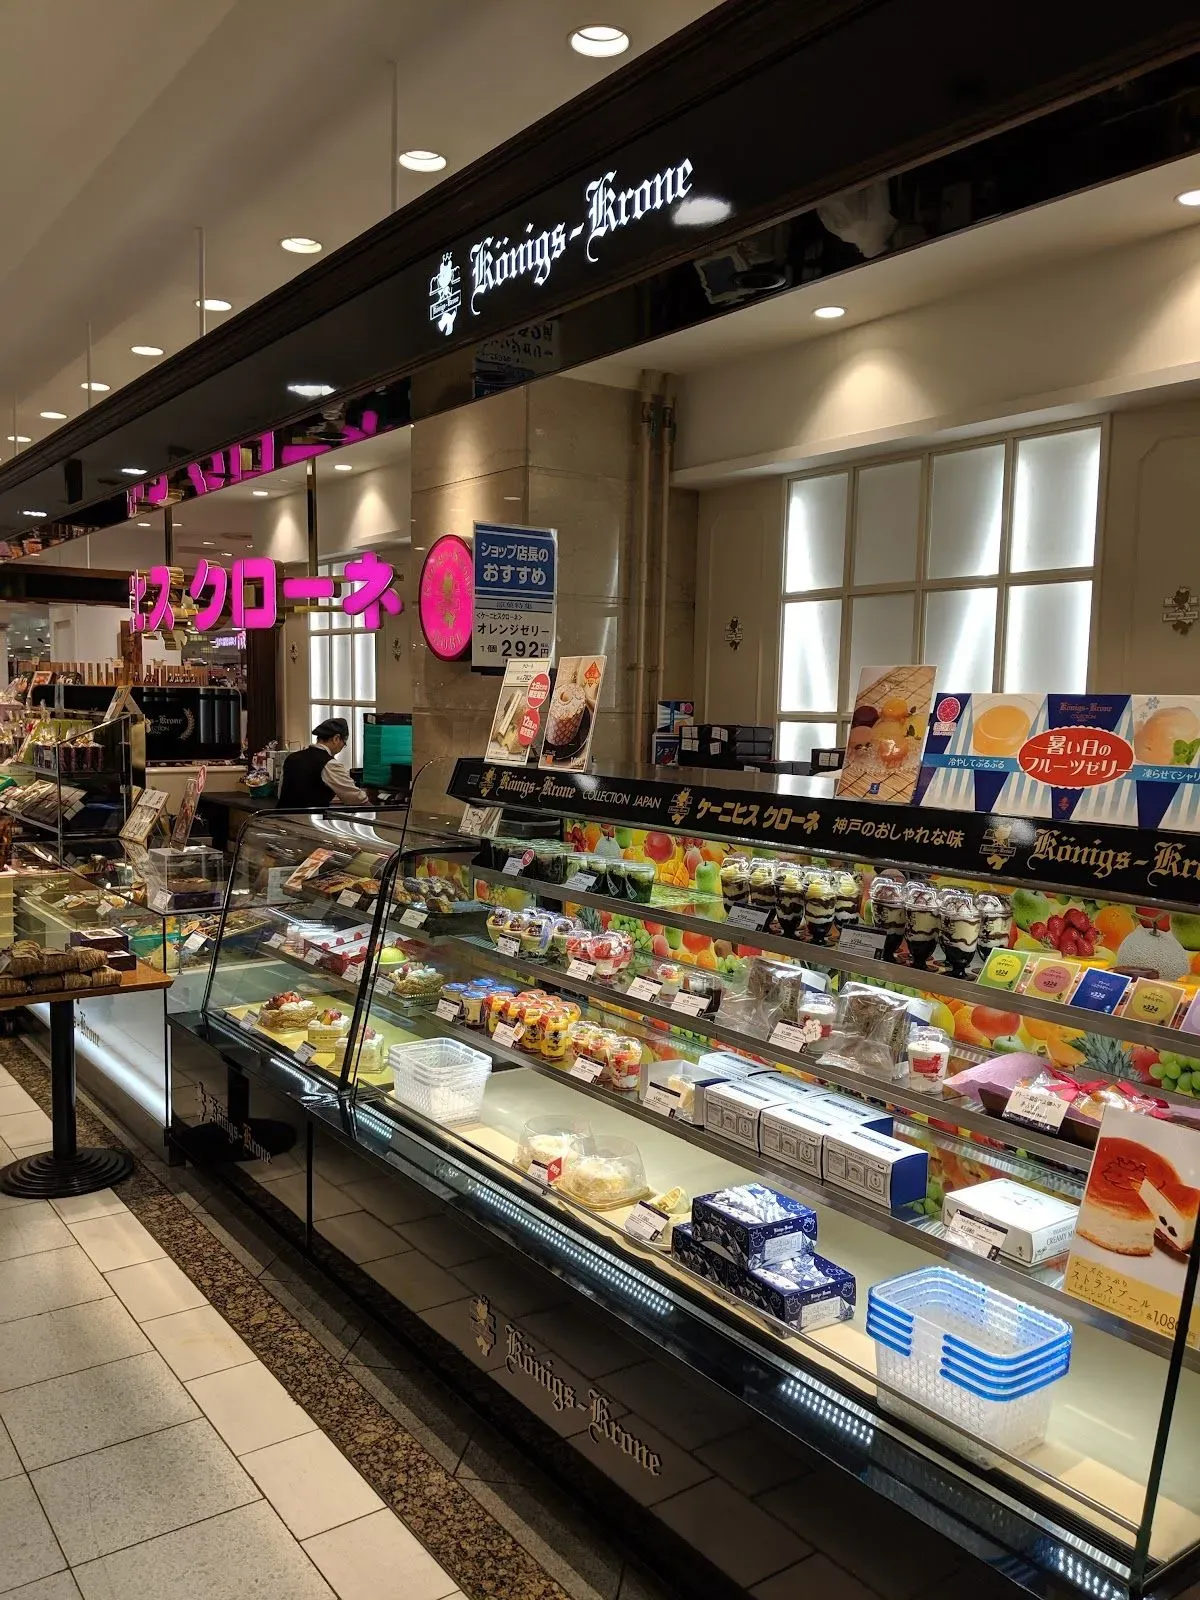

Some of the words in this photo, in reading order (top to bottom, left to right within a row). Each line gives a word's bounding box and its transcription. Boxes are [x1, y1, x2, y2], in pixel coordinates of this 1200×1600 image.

[469, 158, 694, 316] Königs-Krone
[480, 542, 549, 563] ショップ店長の
[482, 563, 547, 586] おすすめ
[477, 623, 550, 637] オレンジゼリー
[1046, 735, 1112, 757] 暑い日の
[1024, 757, 1133, 779] フルーツゼリー
[583, 790, 630, 806] COLLECTION
[632, 795, 662, 809] JAPAN
[832, 816, 965, 849] 神戸のおしゃれな味
